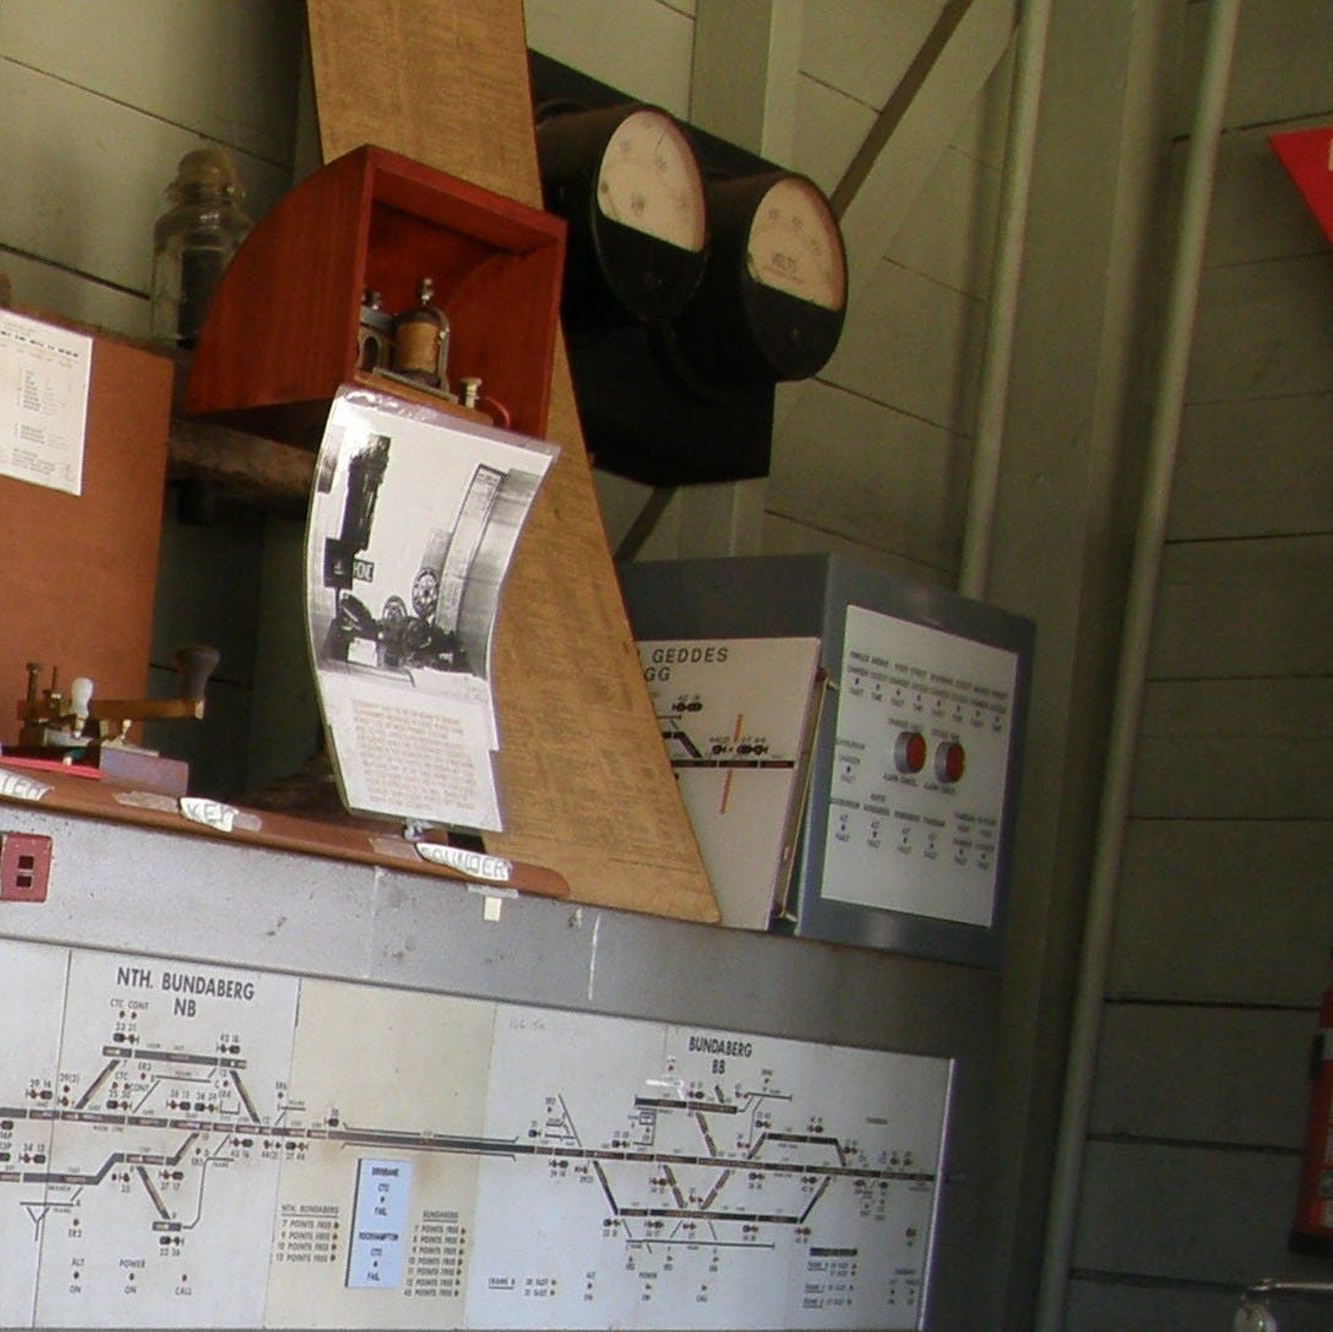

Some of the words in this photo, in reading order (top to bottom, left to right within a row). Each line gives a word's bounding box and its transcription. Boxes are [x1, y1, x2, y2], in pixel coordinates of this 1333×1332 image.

[652, 647, 729, 664] GEDDES
[116, 967, 154, 989] NTH.
[161, 972, 256, 1001] BUNDABERG
[173, 997, 197, 1018] NB
[688, 1036, 753, 1058] BUNDABERG
